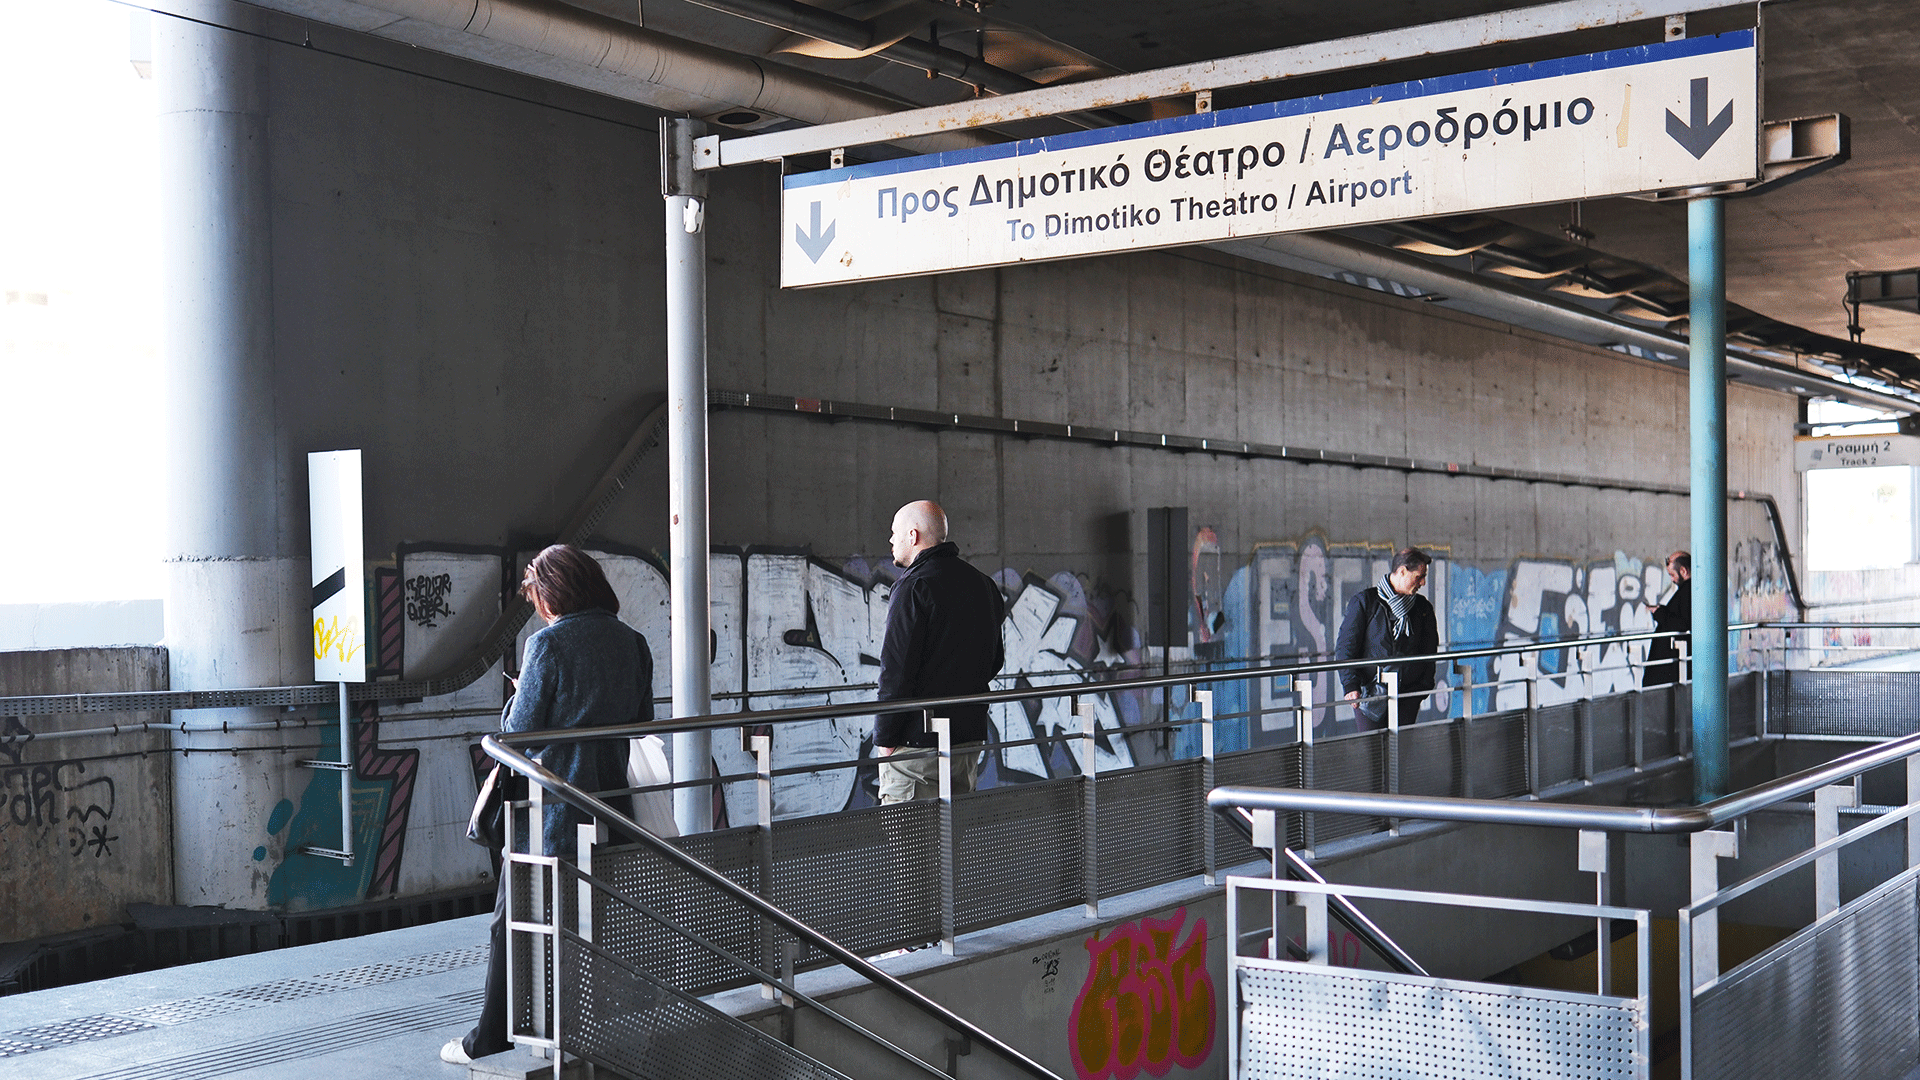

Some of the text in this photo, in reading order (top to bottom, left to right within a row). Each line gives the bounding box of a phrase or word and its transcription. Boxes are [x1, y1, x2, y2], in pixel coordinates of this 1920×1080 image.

[878, 97, 1596, 224] Προς Δημοτικό Θέατρο / Αεροδρόμιο
[1007, 170, 1413, 241] To Dimotiko Theatro / Airport
[1827, 440, 1891, 456] Γραμμή 2
[1841, 456, 1877, 466] Track 2
